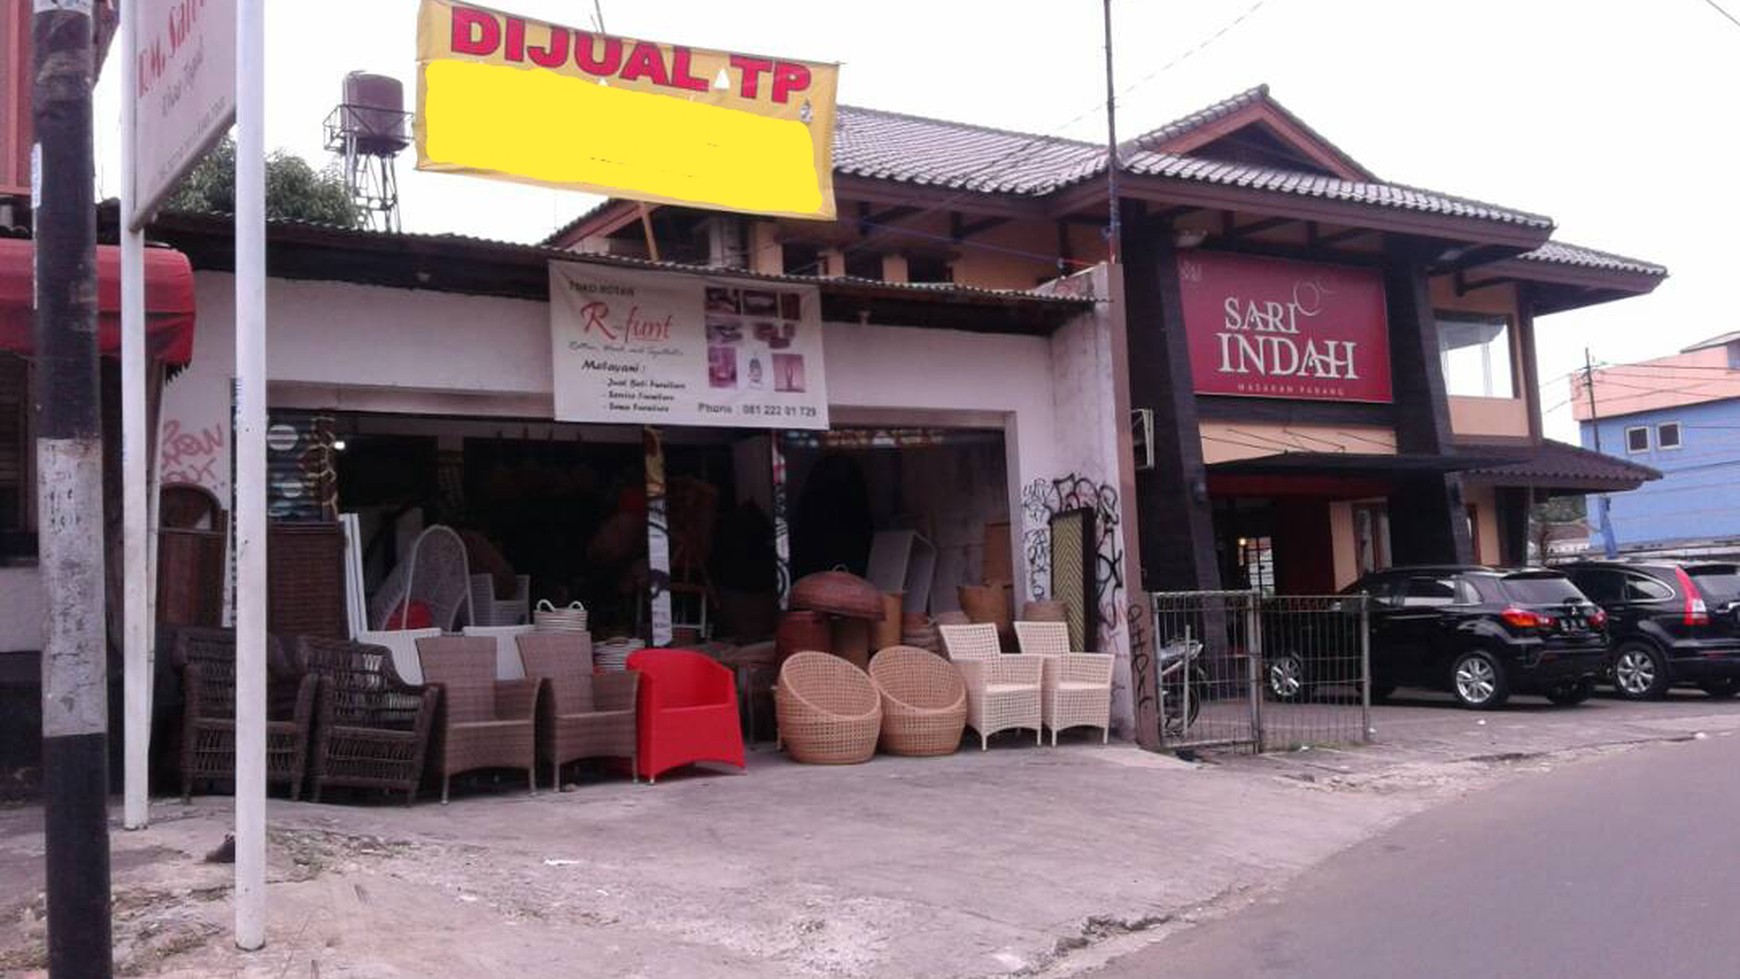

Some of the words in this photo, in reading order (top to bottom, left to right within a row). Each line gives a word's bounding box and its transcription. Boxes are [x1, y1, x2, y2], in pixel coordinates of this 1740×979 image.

[451, 6, 709, 92] DIJUAL
[730, 54, 811, 104] TP
[1224, 296, 1300, 334] SARI
[1216, 332, 1359, 380] INDAH
[698, 402, 733, 414] Phone
